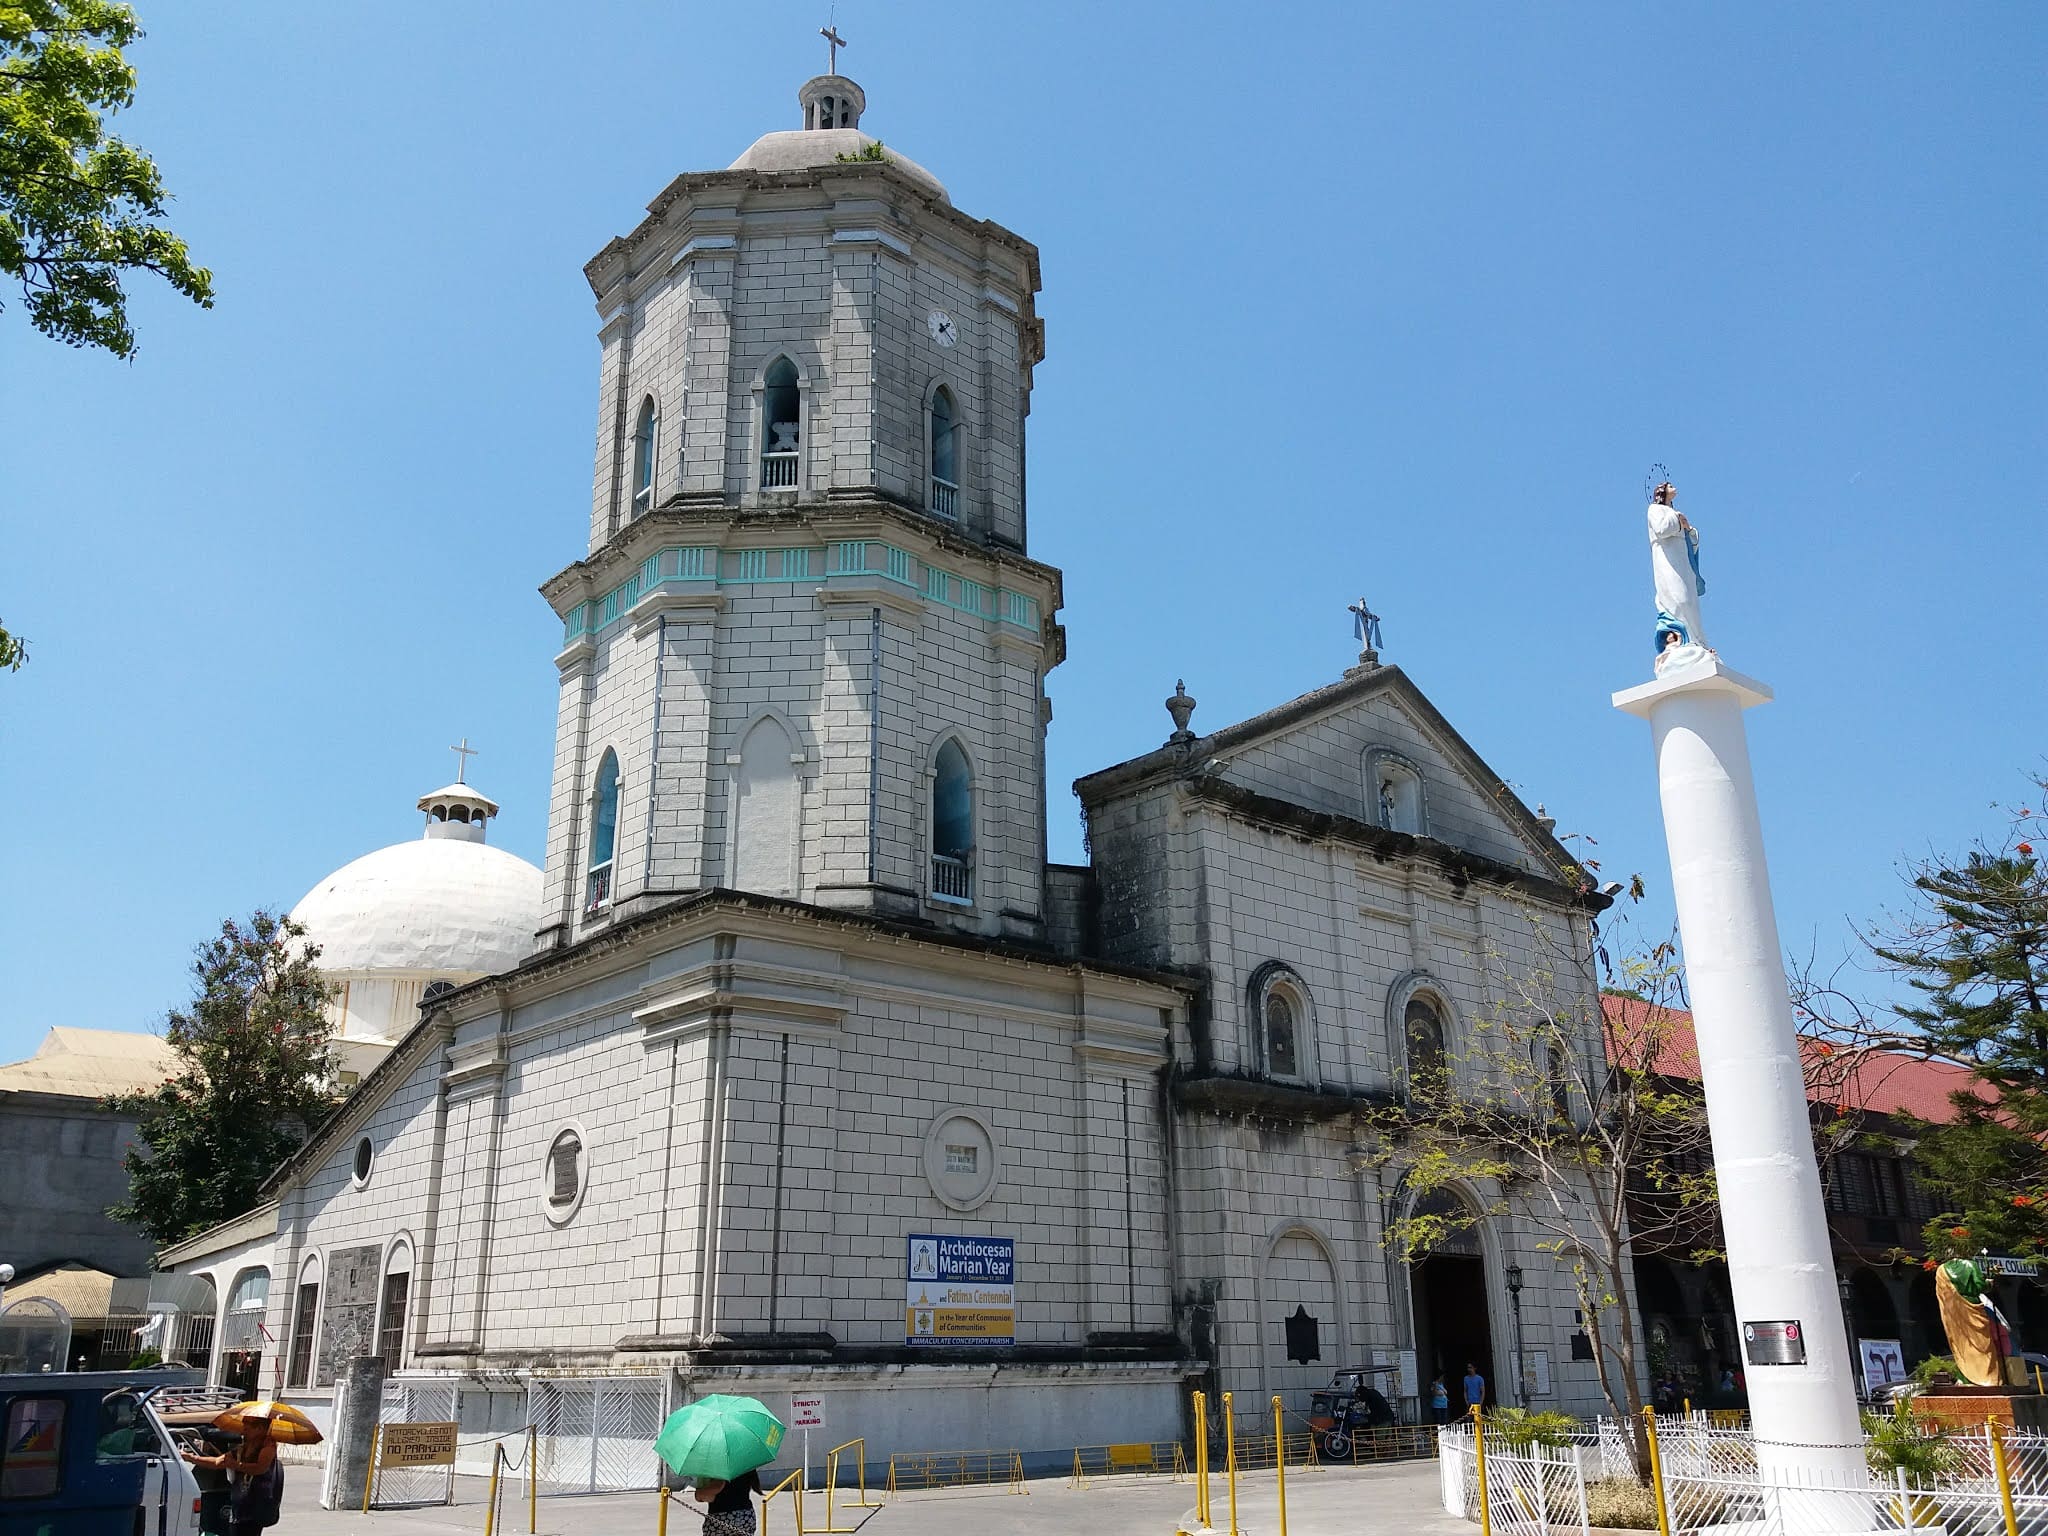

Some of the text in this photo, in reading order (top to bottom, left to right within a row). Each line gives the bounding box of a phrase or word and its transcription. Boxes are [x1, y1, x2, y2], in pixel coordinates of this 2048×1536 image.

[940, 1240, 1011, 1257] Archdiocesan
[940, 1256, 1010, 1274] Marian Year
[948, 1289, 972, 1303] Fatima
[975, 1289, 1011, 1304] Centennial
[955, 1313, 967, 1321] Year
[912, 1337, 950, 1345] IMMACULATE
[952, 1337, 988, 1345] CONCEPTION
[387, 1444, 452, 1454] NO PARKING
